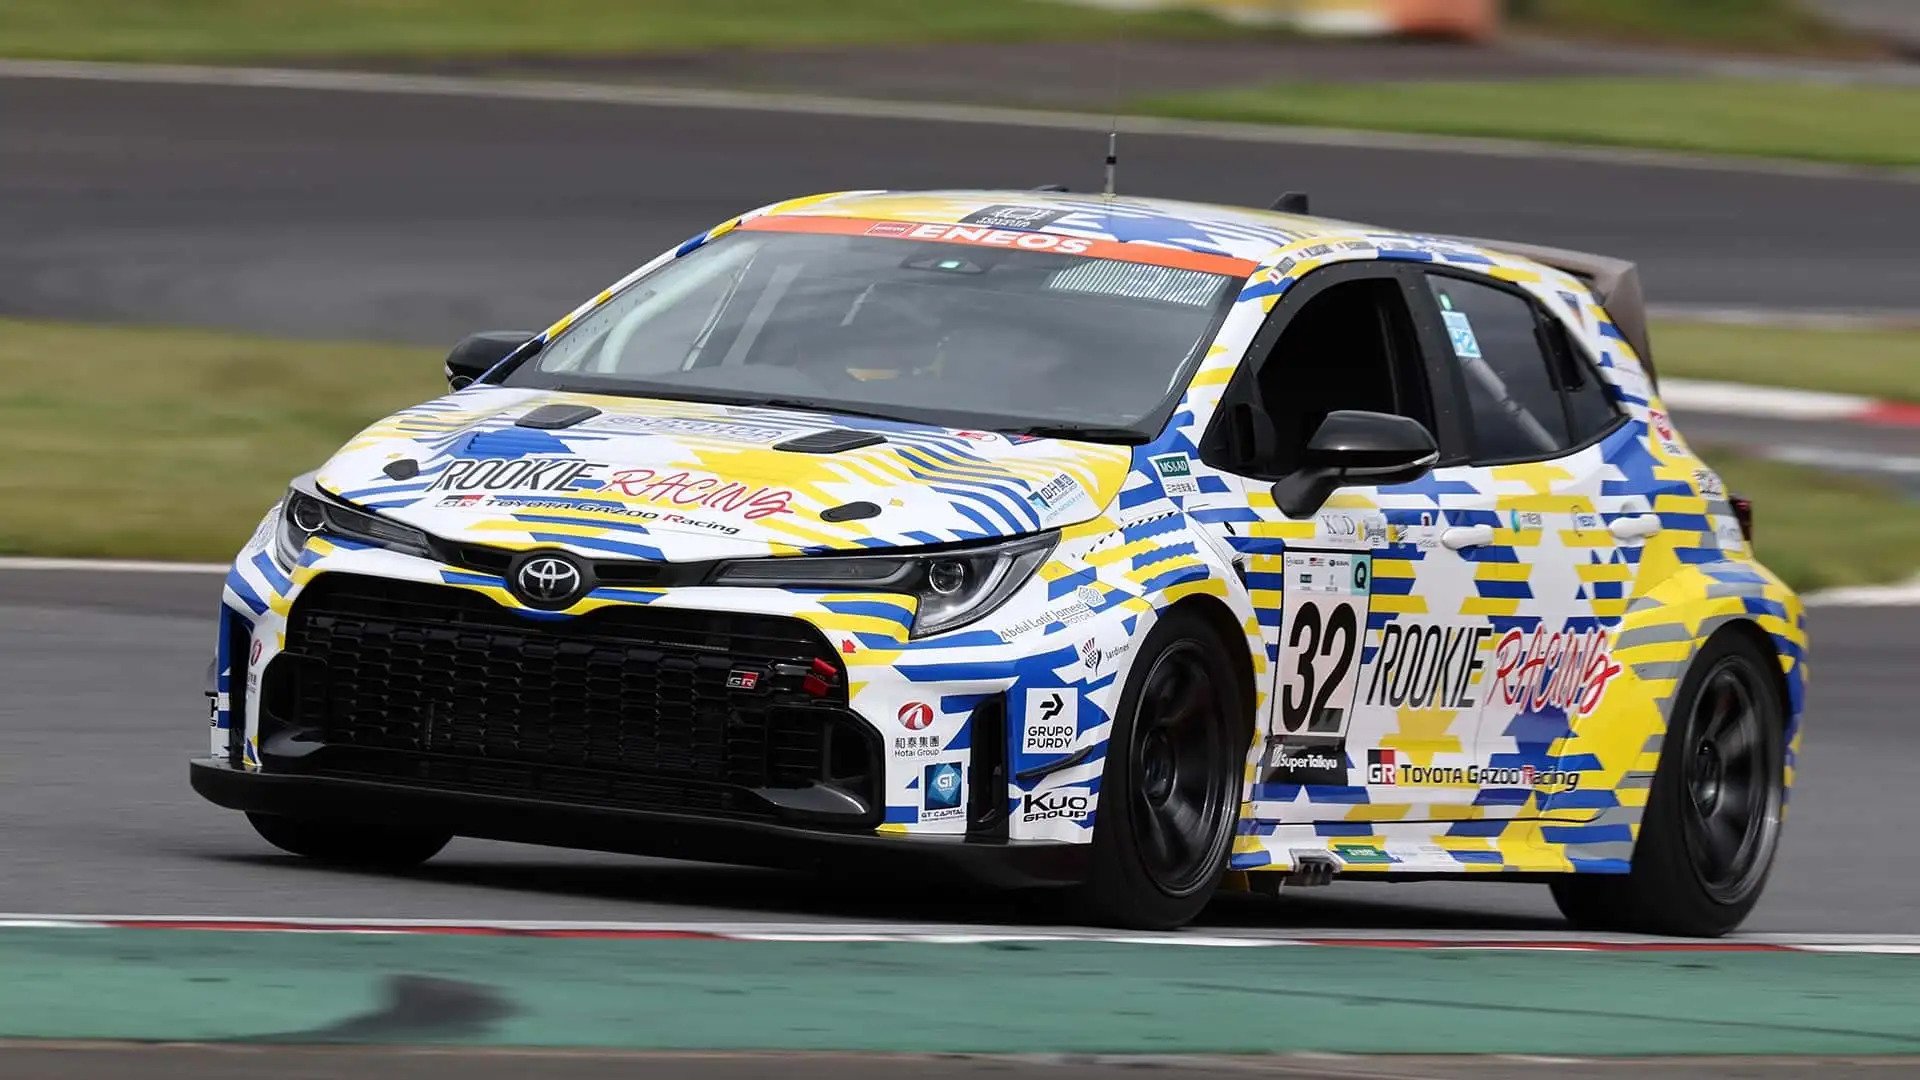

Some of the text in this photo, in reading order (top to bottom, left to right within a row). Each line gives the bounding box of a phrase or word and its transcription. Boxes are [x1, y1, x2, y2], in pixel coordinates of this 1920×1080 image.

[908, 224, 1093, 254] ENEOS
[1159, 460, 1188, 474] MS&AD
[426, 458, 794, 519] ROOKIE RACING
[484, 499, 579, 513] TOYOTA
[580, 504, 659, 520] GAZOO
[663, 513, 741, 536] Racing
[1354, 560, 1367, 590] Q
[1000, 602, 1088, 642] Abdul Latif Jameel
[1282, 601, 1358, 733] 32
[1366, 623, 1621, 714] ROOKIE RACING
[729, 677, 755, 687] GR
[1028, 726, 1074, 737] GRUPO
[894, 748, 940, 758] Hotai Group
[1027, 737, 1072, 749] PURDY
[936, 773, 955, 786] GT
[1368, 763, 1580, 792] GR TOYOTA GAZOO Racing
[934, 808, 964, 818] CAPITAL
[1023, 792, 1088, 813] KUO
[1023, 811, 1088, 823] GROUP
